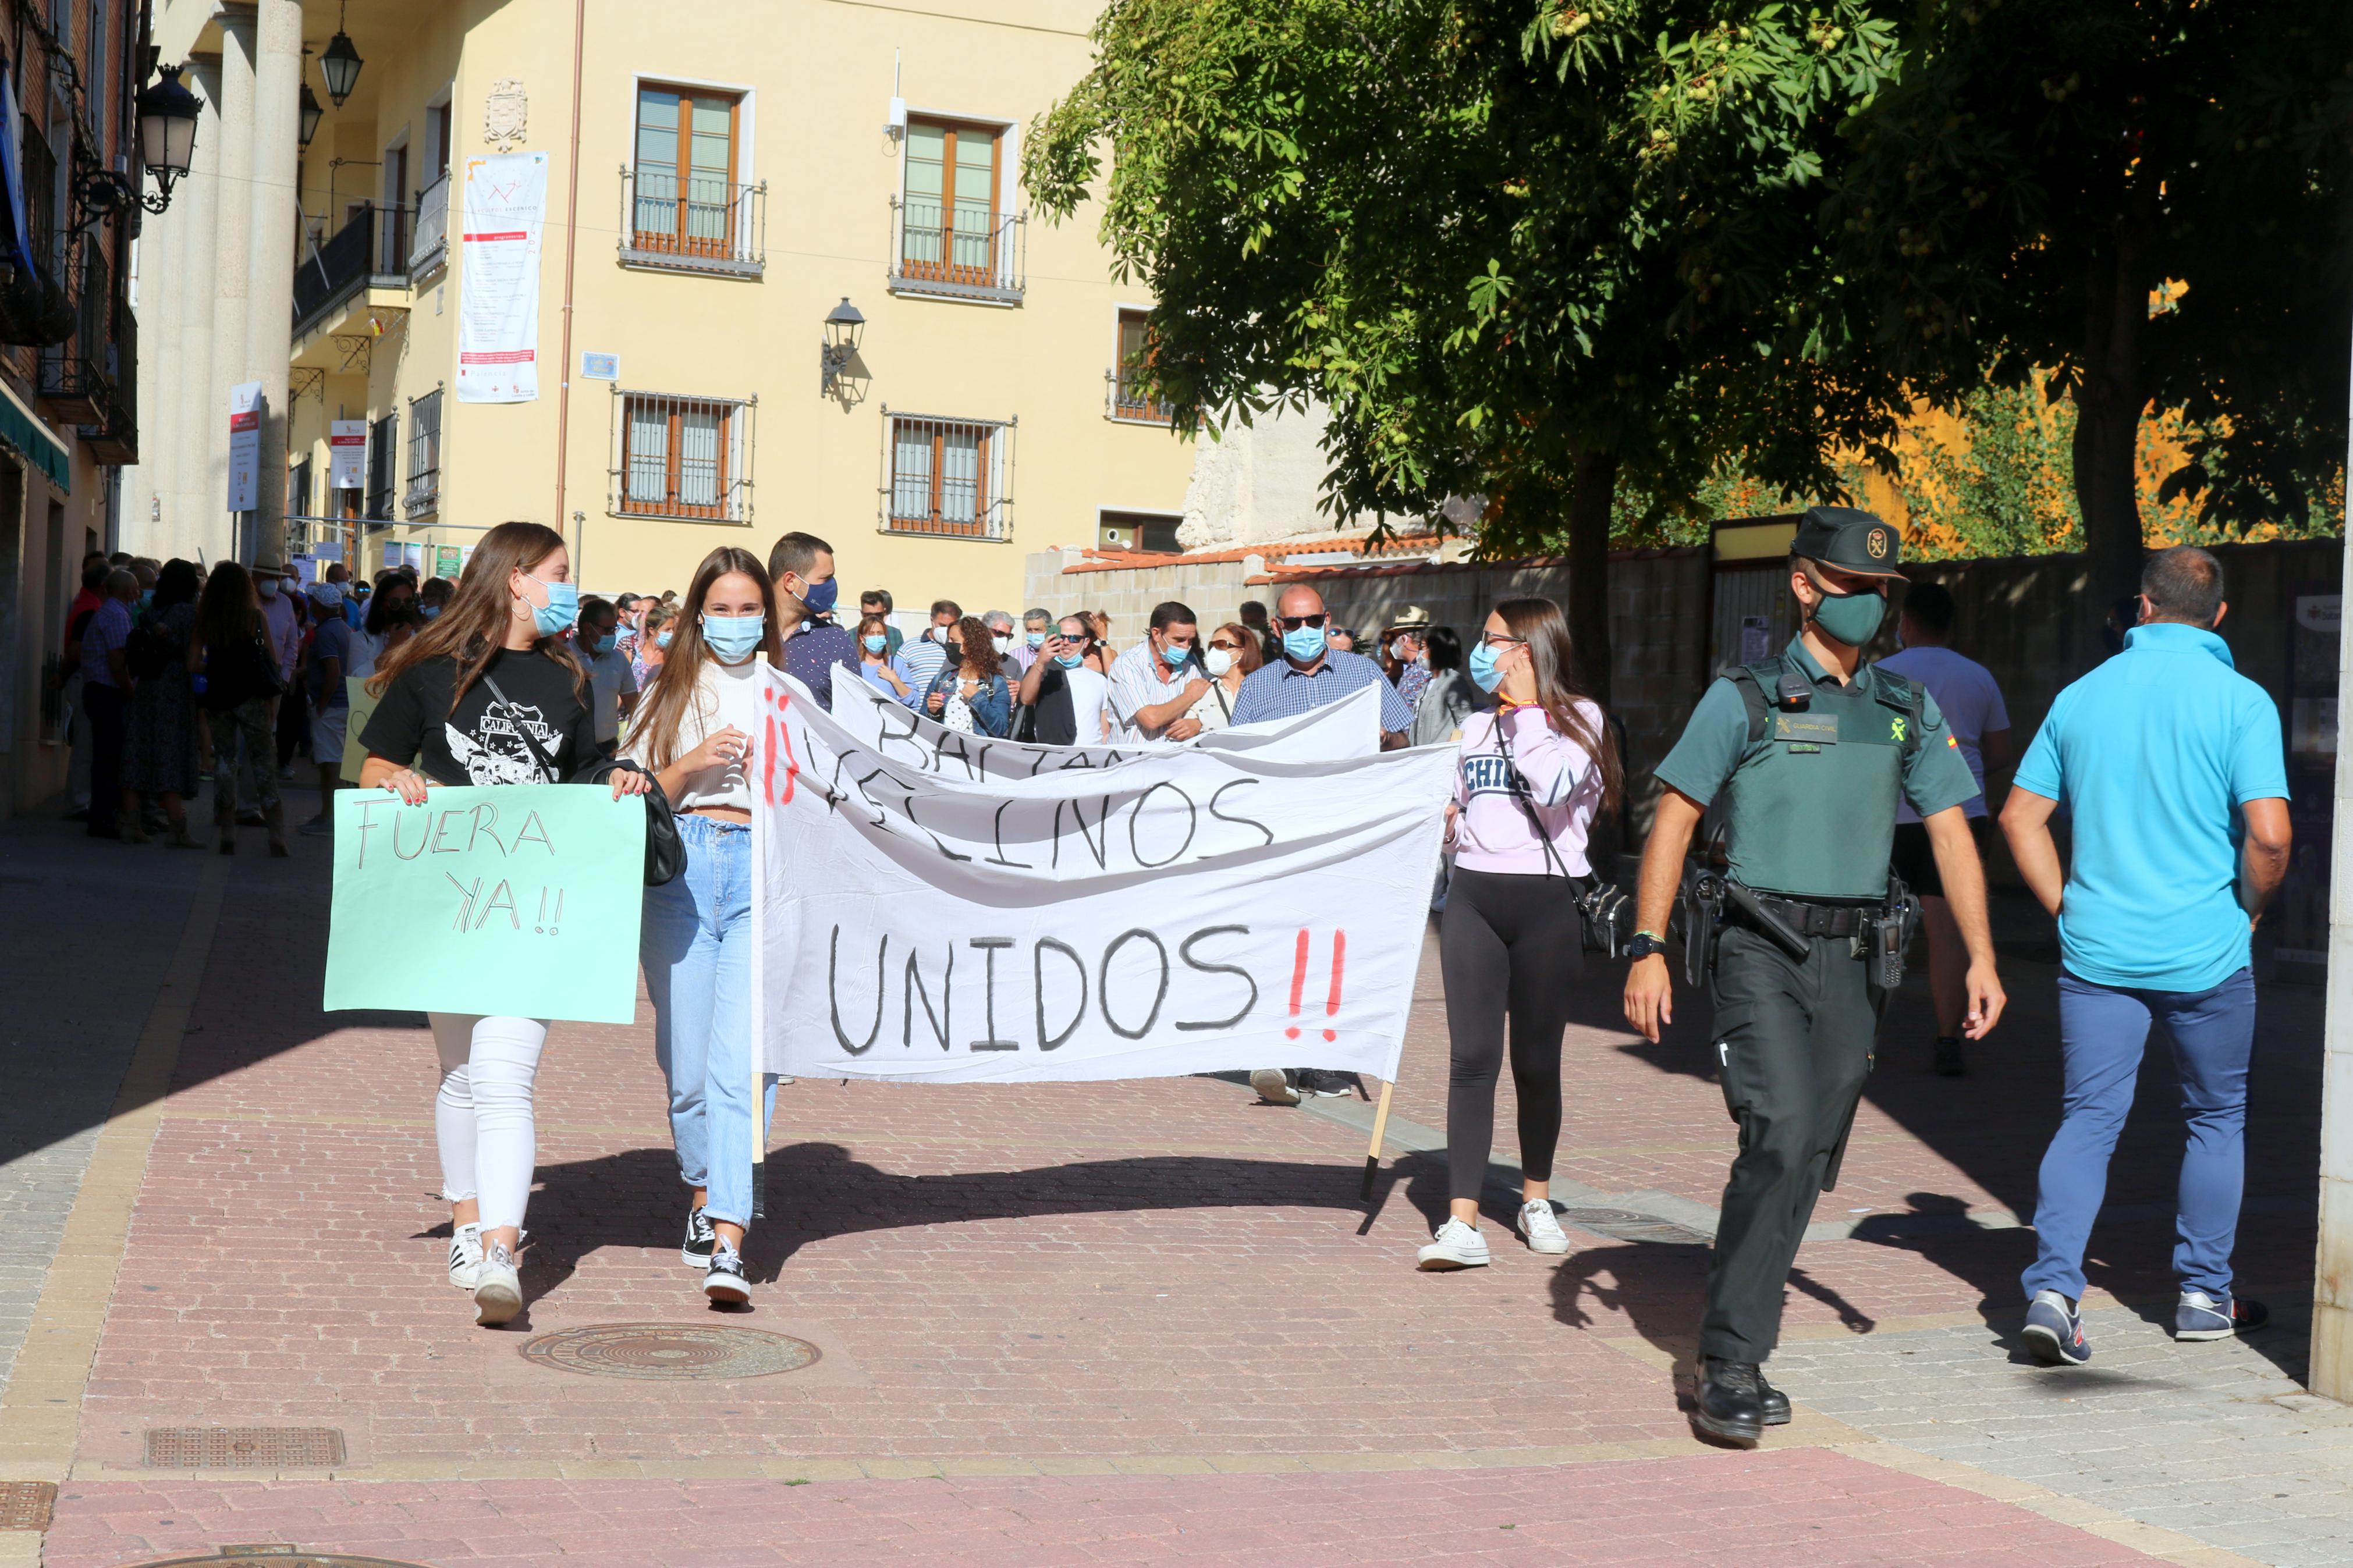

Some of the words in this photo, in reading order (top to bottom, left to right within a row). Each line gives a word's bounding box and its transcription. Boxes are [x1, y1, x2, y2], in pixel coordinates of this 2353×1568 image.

[482, 719, 545, 736] CALIFONIA
[1793, 723, 1819, 731] GUARDIA
[354, 798, 556, 870] FUERA
